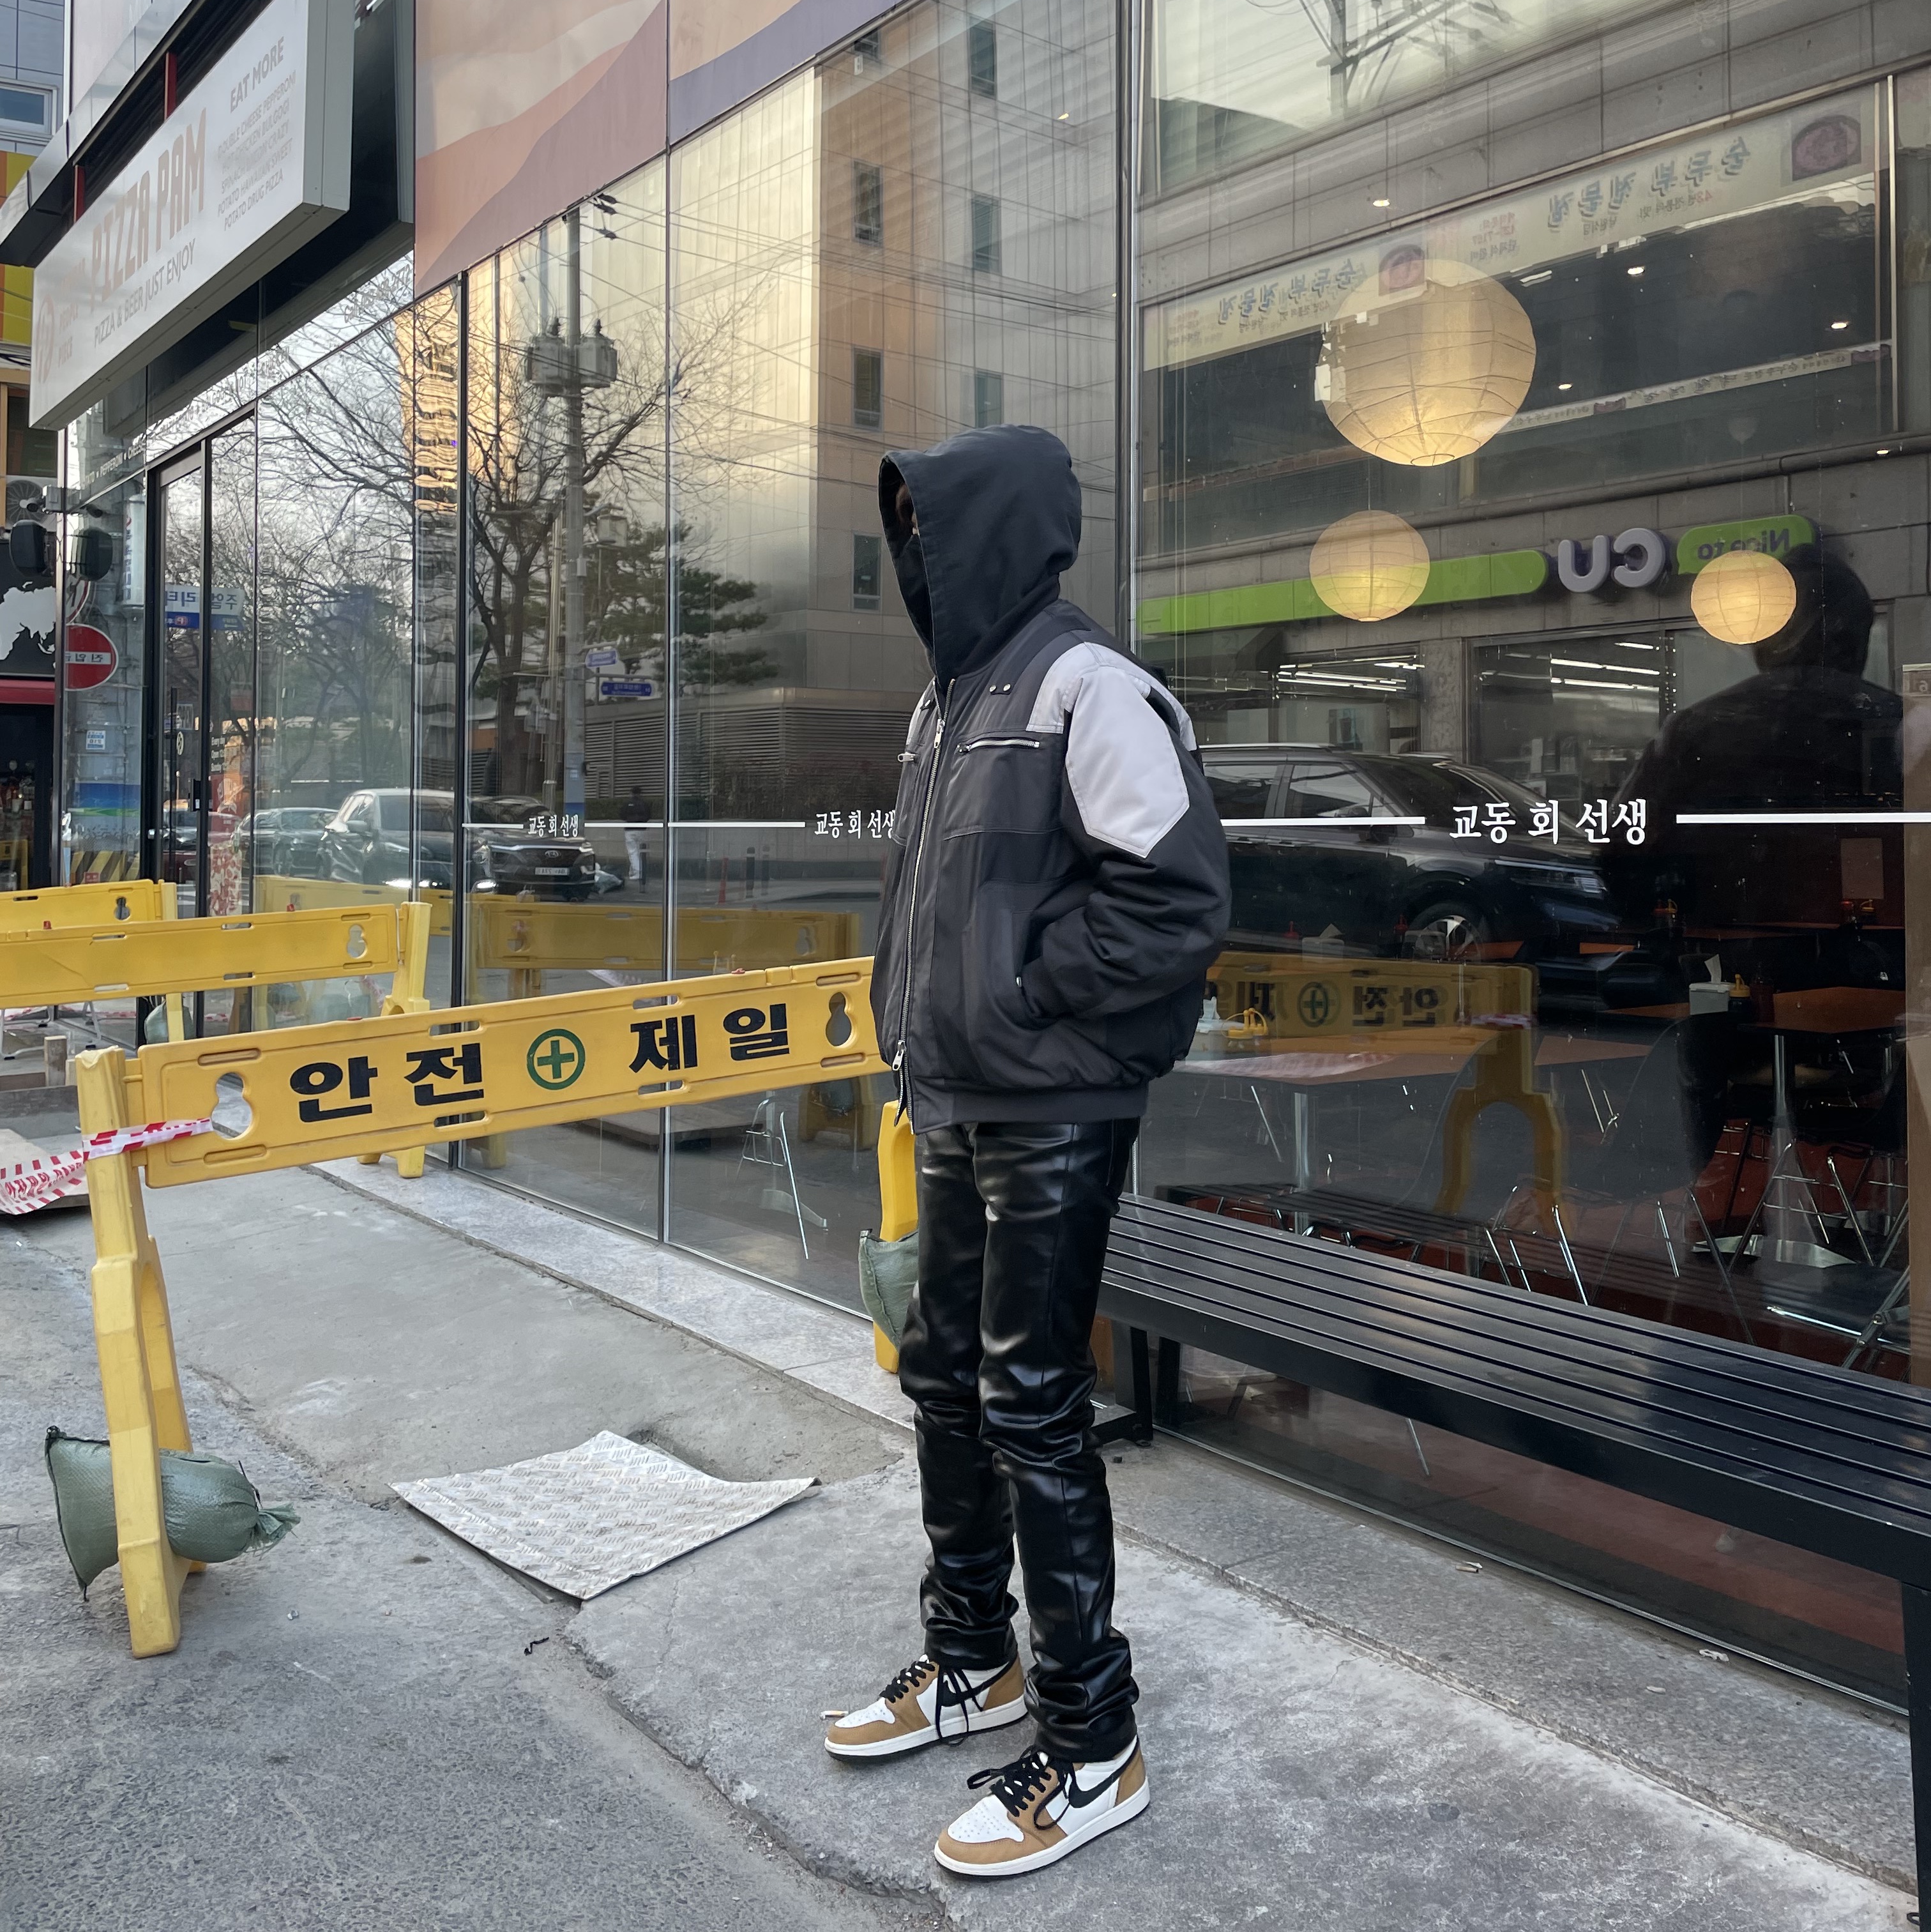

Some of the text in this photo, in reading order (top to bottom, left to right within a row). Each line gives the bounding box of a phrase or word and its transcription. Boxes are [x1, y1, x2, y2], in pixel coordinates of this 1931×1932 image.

[230, 36, 284, 114] EAT MORE
[90, 107, 207, 316] PIZZA PAM
[223, 200, 246, 232] POTATO
[265, 168, 284, 195] PIZZA
[94, 310, 116, 348] PIZZA
[116, 306, 123, 327] &
[124, 285, 144, 321] BEER
[144, 266, 165, 312] JUST
[166, 238, 196, 285] ENJOY
[527, 814, 579, 837] 교동 회 선생
[814, 811, 844, 839] 교동
[847, 809, 861, 839] 회
[1449, 798, 1647, 845] 교동 회 선생
[290, 1003, 790, 1123] 안전 제일
